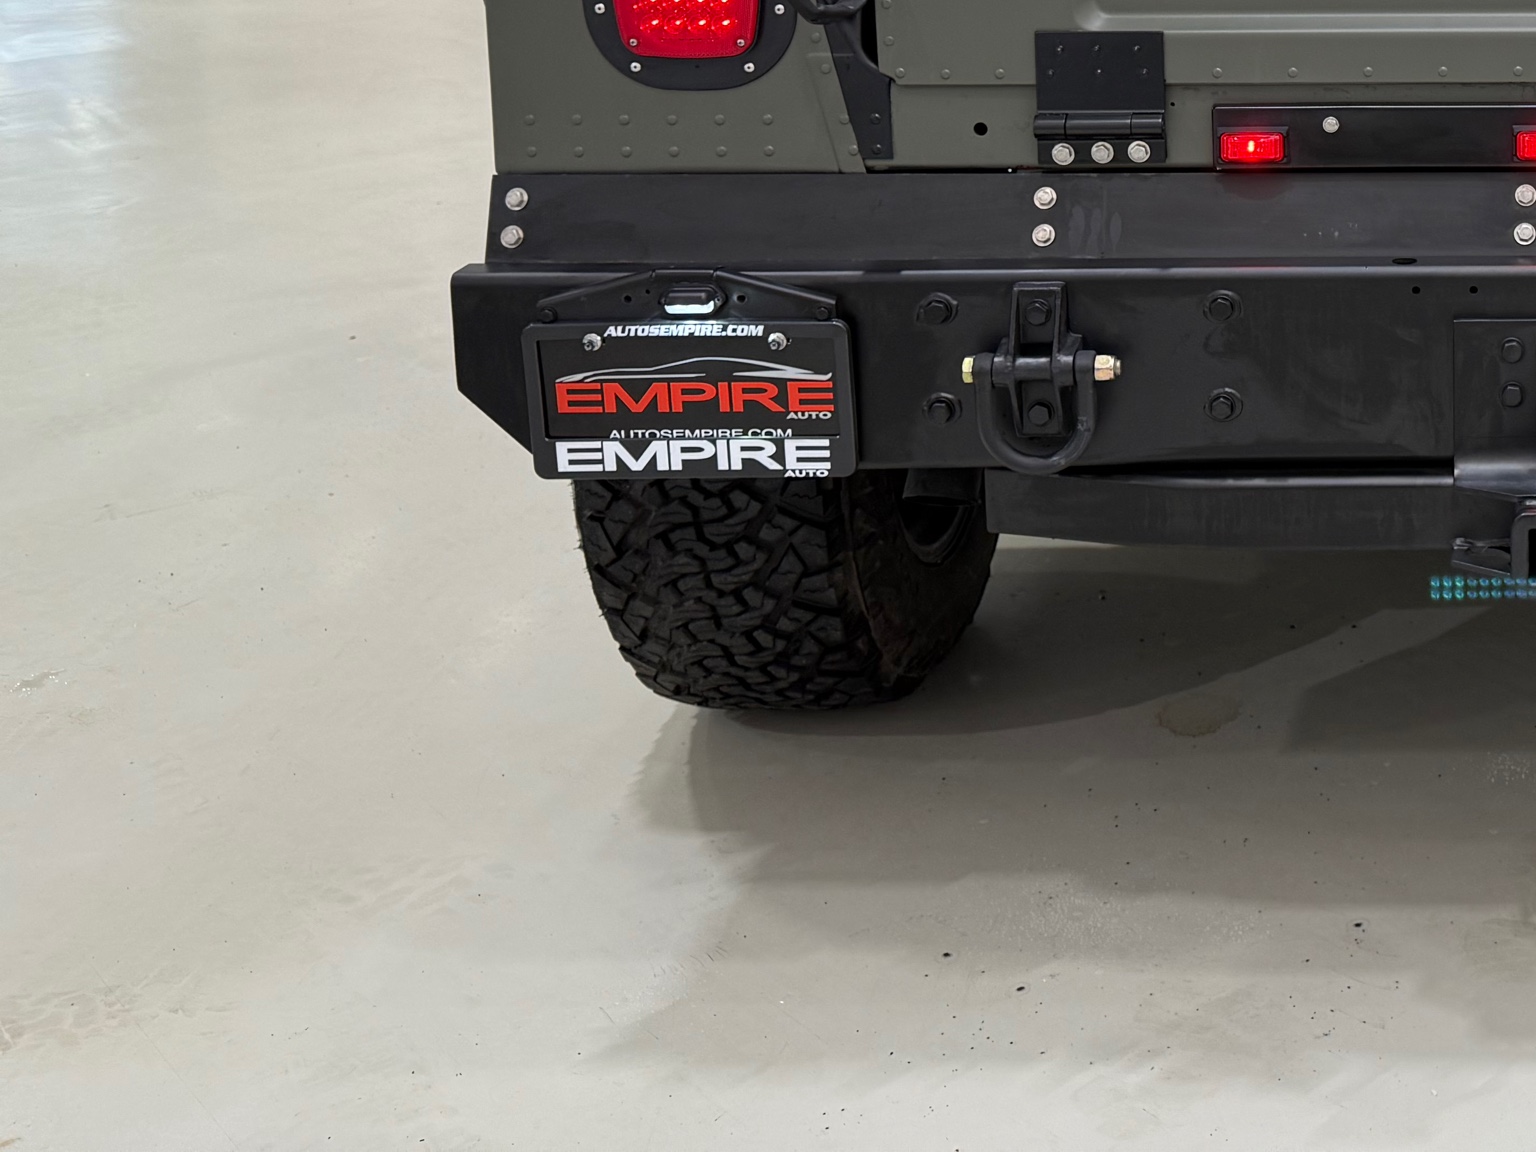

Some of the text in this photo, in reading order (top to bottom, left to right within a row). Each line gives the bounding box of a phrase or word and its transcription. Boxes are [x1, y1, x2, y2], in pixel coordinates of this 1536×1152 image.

[603, 324, 765, 338] AUTOSEMPIRE.COM
[555, 381, 834, 413] EMPIRE
[786, 411, 832, 420] AUTO
[609, 428, 792, 438] AUTOSEMPIRECOM
[555, 439, 832, 473] EMPIRE
[784, 469, 829, 478] AUTO
